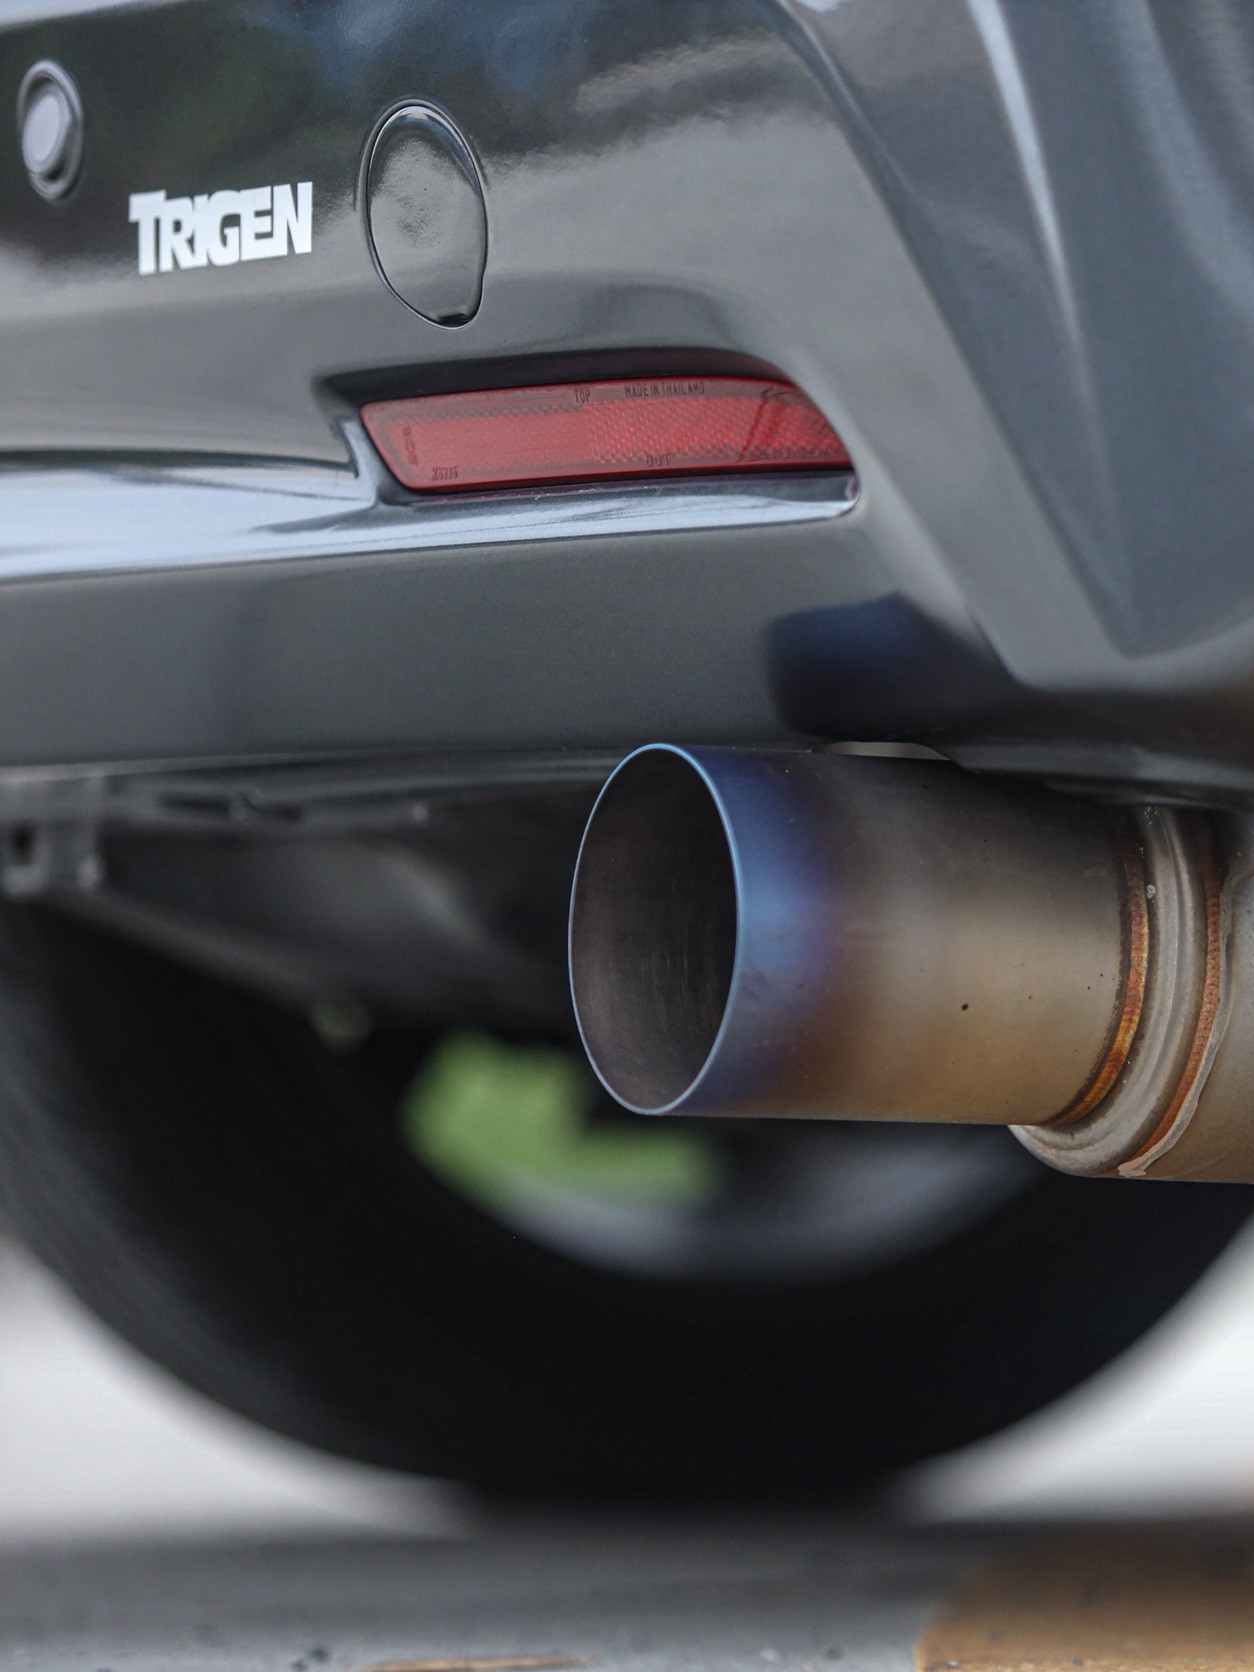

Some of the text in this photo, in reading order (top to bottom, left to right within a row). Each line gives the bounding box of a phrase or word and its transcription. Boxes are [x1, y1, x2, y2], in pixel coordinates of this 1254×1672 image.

[128, 181, 313, 276] TRIGEN
[574, 387, 591, 404] TOP
[624, 380, 705, 398] MADE IN THAILAND
